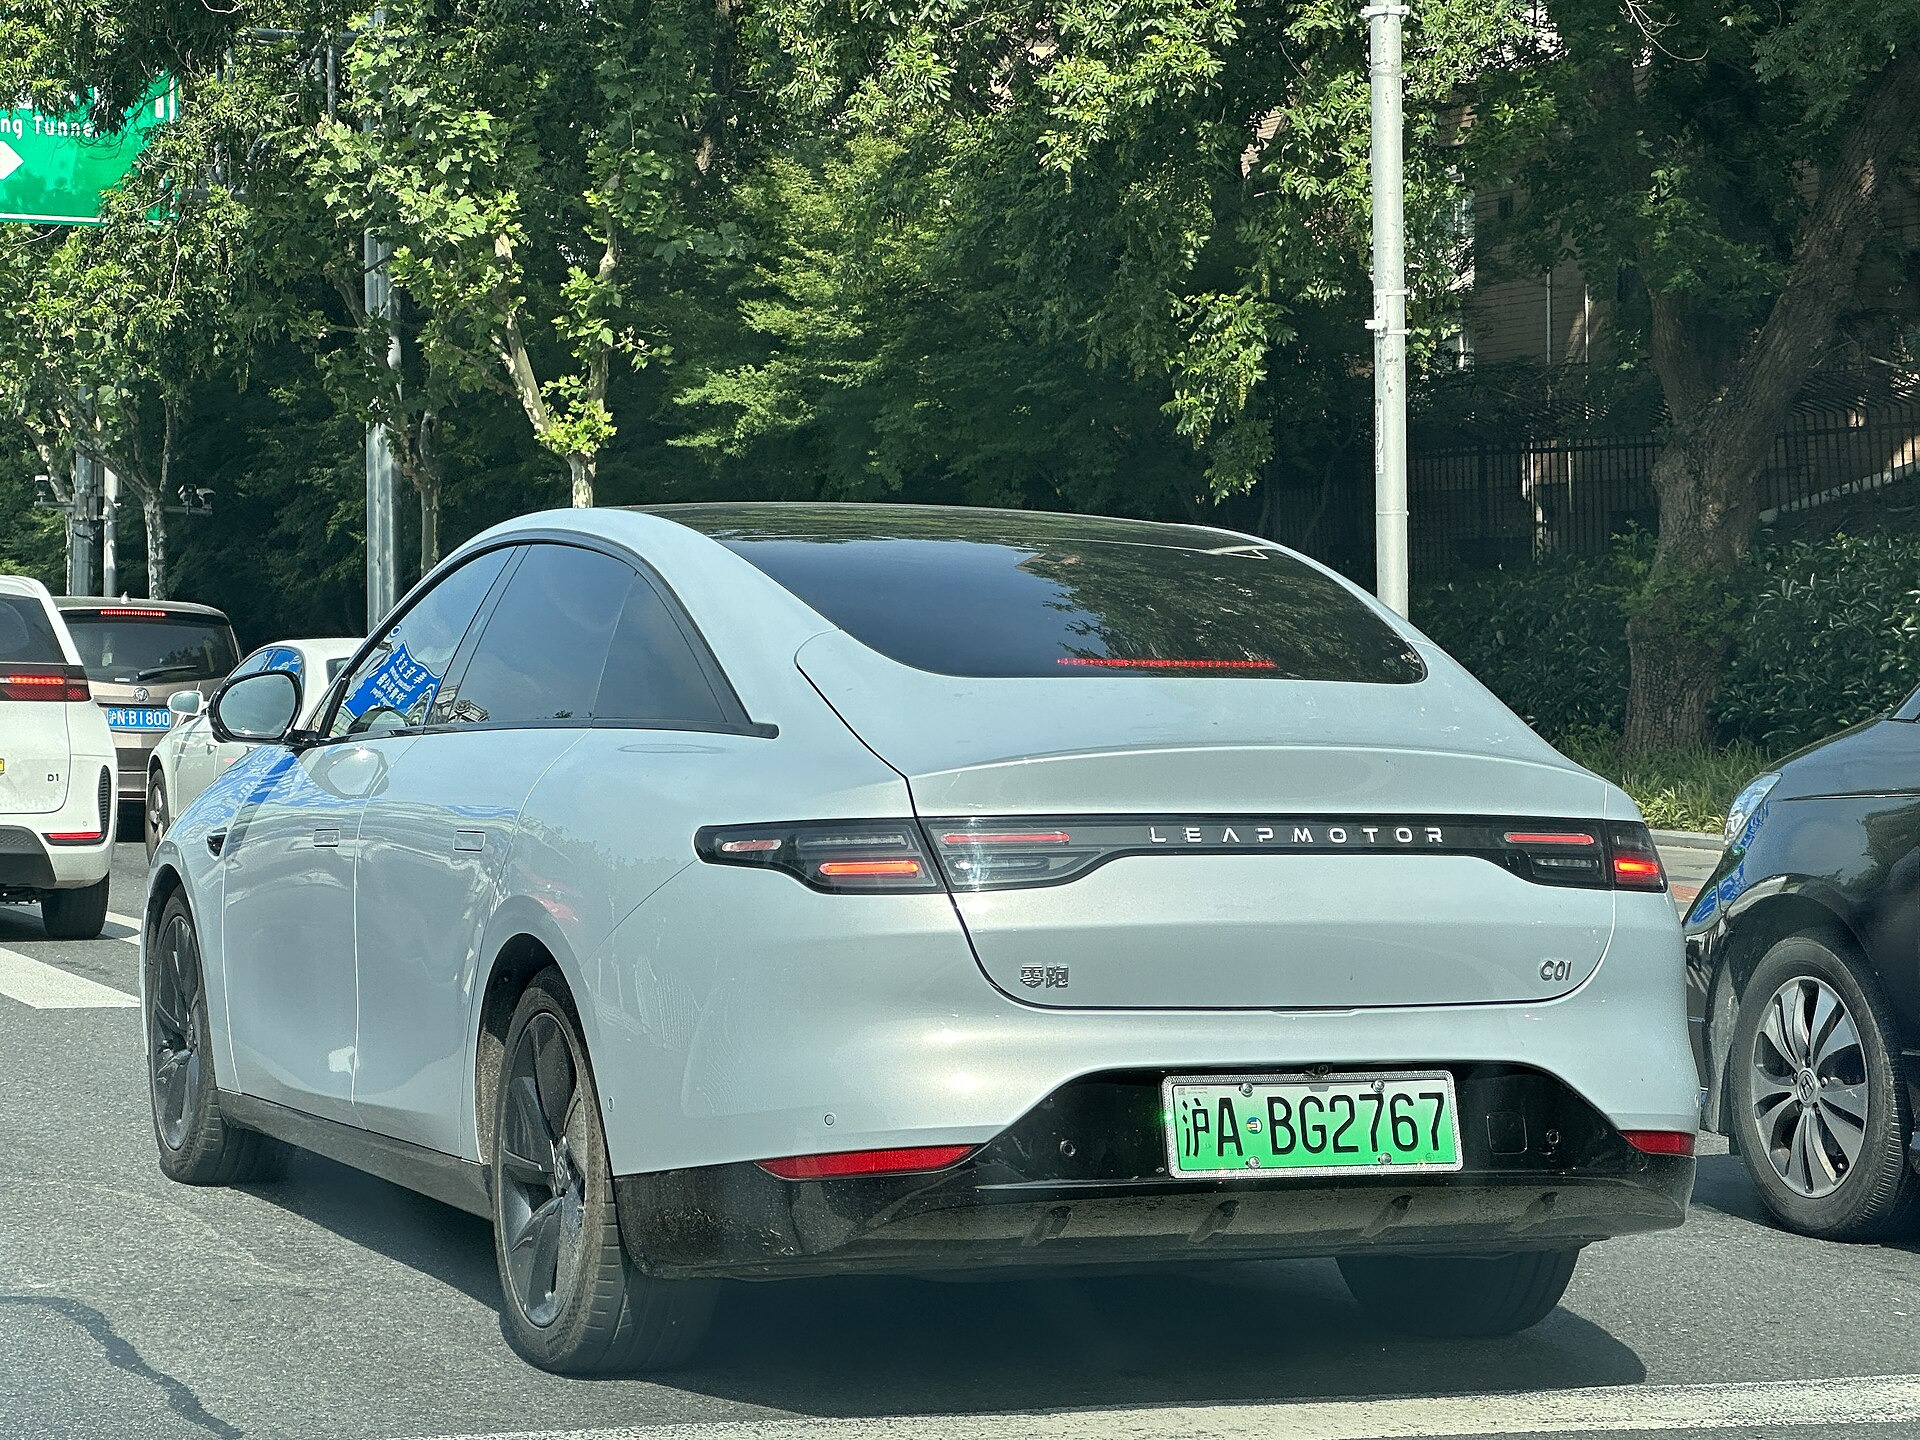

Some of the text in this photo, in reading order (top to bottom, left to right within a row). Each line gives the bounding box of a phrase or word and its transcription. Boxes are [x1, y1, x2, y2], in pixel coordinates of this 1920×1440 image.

[33, 115, 99, 137] Tunne
[47, 773, 60, 782] D1
[1150, 827, 1443, 843] LEAPMOTOR
[1020, 963, 1069, 989] 零跑
